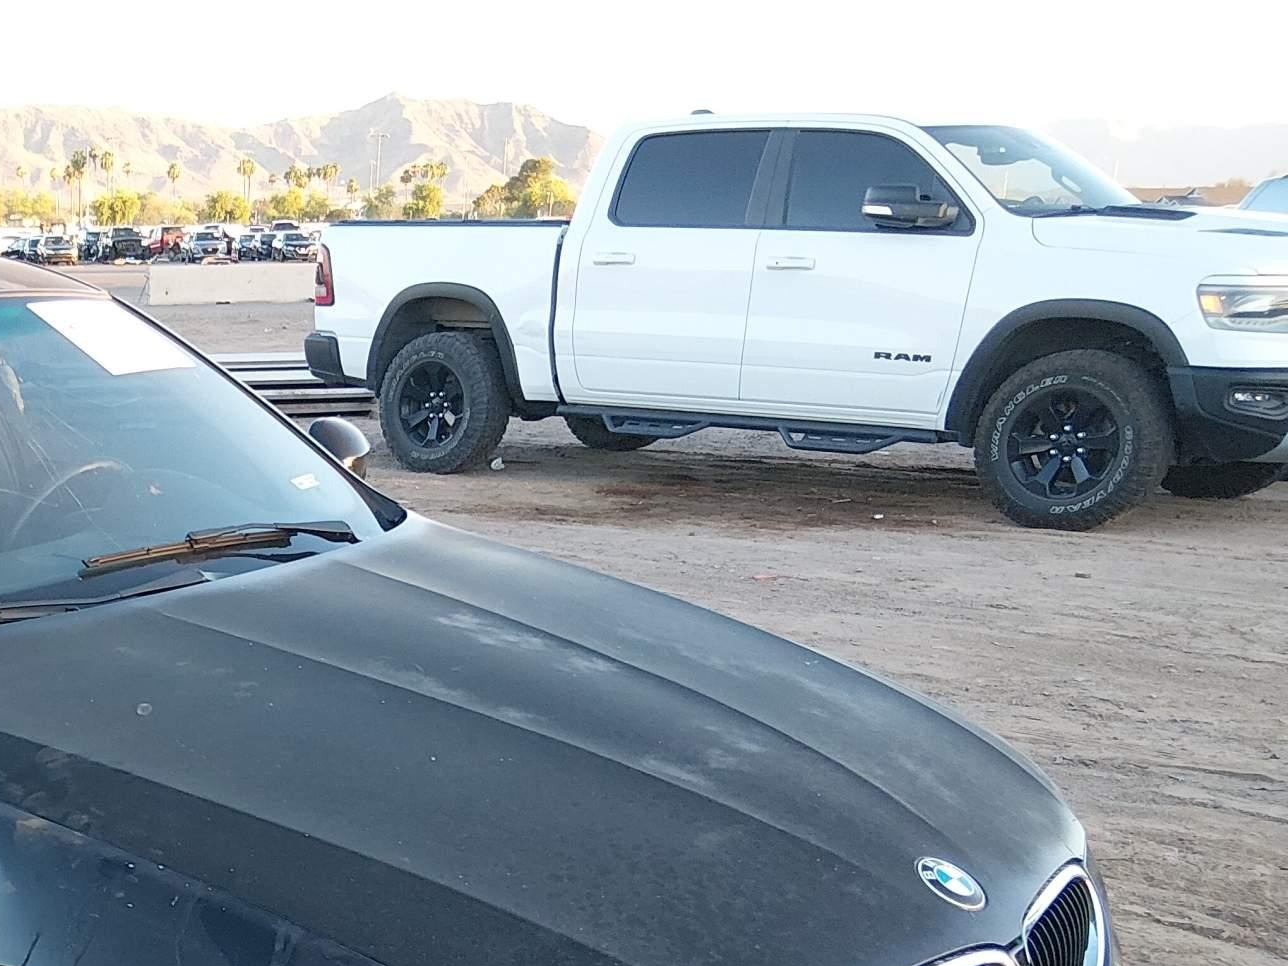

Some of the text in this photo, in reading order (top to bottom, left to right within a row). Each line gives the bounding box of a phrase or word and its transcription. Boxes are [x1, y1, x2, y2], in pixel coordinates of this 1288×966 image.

[873, 352, 932, 363] RAM
[990, 375, 1068, 462] WRANGLER
[1049, 425, 1134, 514] GOODYEAR
